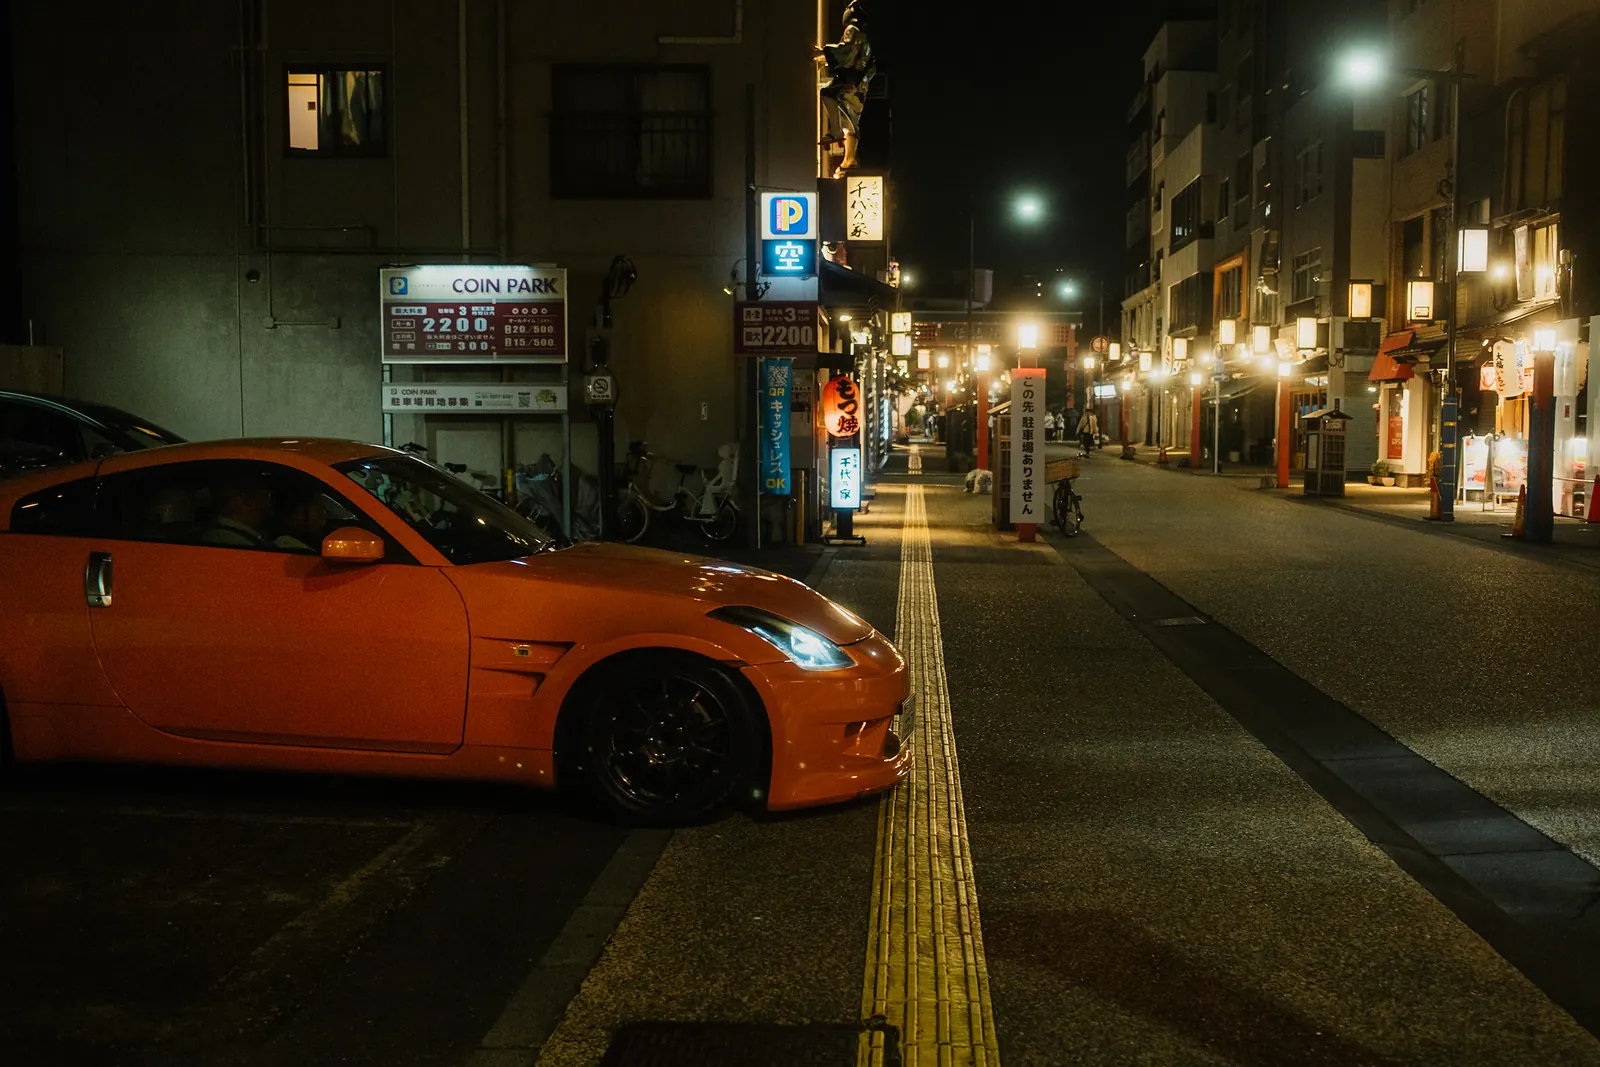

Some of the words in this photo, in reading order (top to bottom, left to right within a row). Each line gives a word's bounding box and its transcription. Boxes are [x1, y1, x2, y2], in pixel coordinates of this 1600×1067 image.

[775, 241, 803, 270] 空
[452, 278, 500, 294] COIN
[507, 278, 558, 294] PARK
[459, 306, 467, 316] 3
[784, 307, 797, 322] 3
[769, 387, 785, 397] QR
[1022, 377, 1035, 413] この先
[836, 380, 858, 433] もつ焼
[770, 400, 783, 474] キャッシュレス
[1022, 416, 1035, 515] 駐車場ありません
[766, 478, 785, 489] OK
